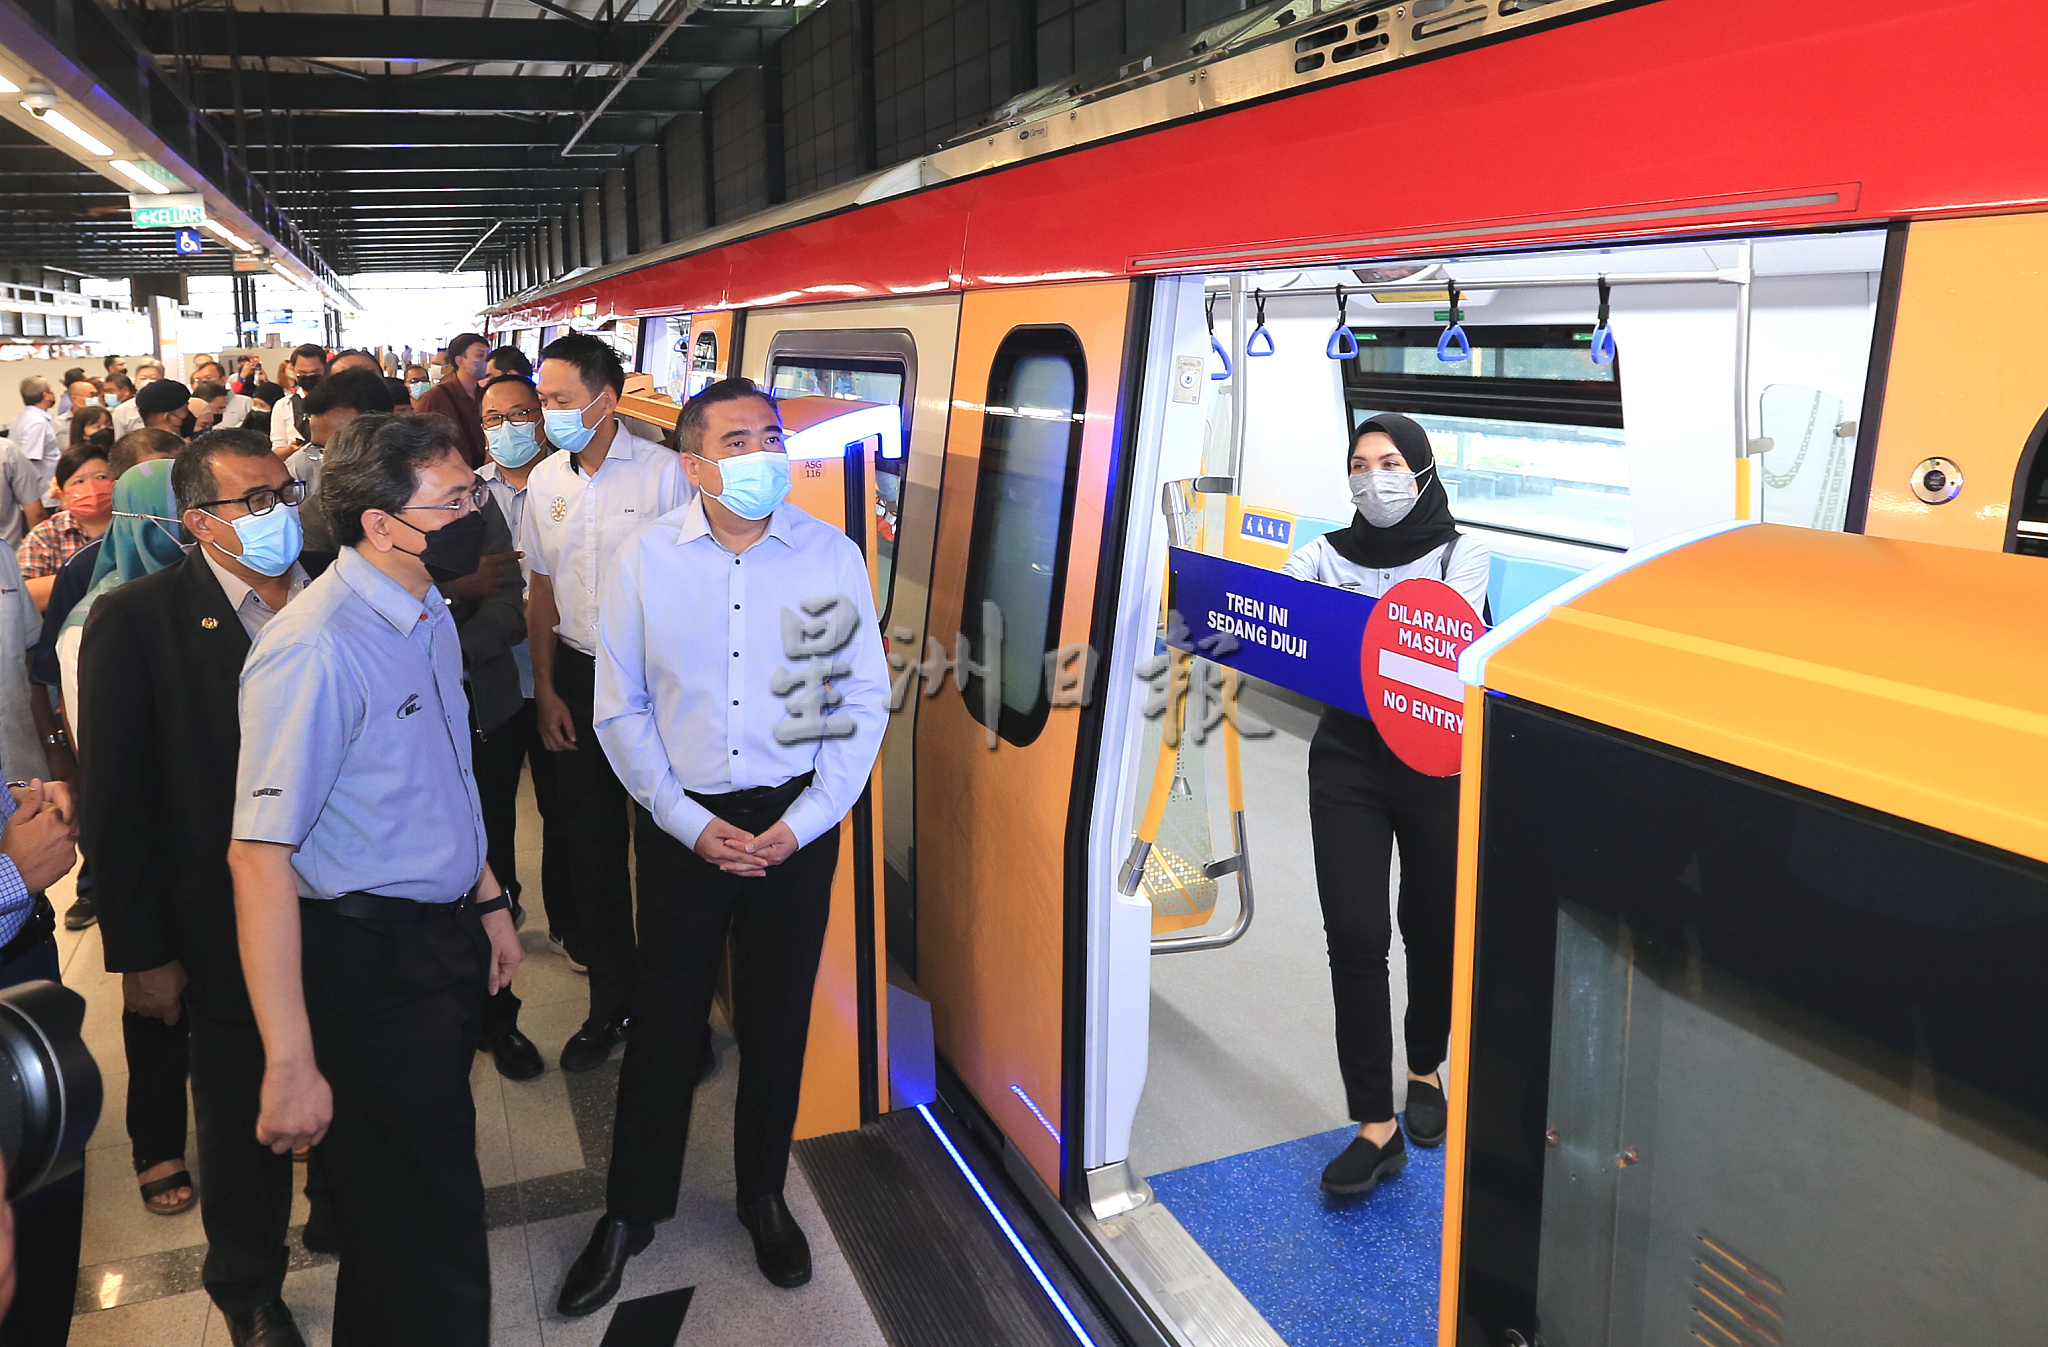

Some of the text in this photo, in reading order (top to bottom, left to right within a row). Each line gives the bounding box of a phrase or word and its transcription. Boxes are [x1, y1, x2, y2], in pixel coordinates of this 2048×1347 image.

[150, 207, 200, 224] KELUAR
[804, 461, 822, 469] ASG
[806, 470, 821, 478] 116
[1226, 591, 1289, 628] TREN INI
[1388, 602, 1473, 642] DILARANG
[1207, 610, 1308, 660] SEDANG DIUJI
[1398, 628, 1458, 662] MASUK
[1383, 689, 1464, 735] NO ENTRY
